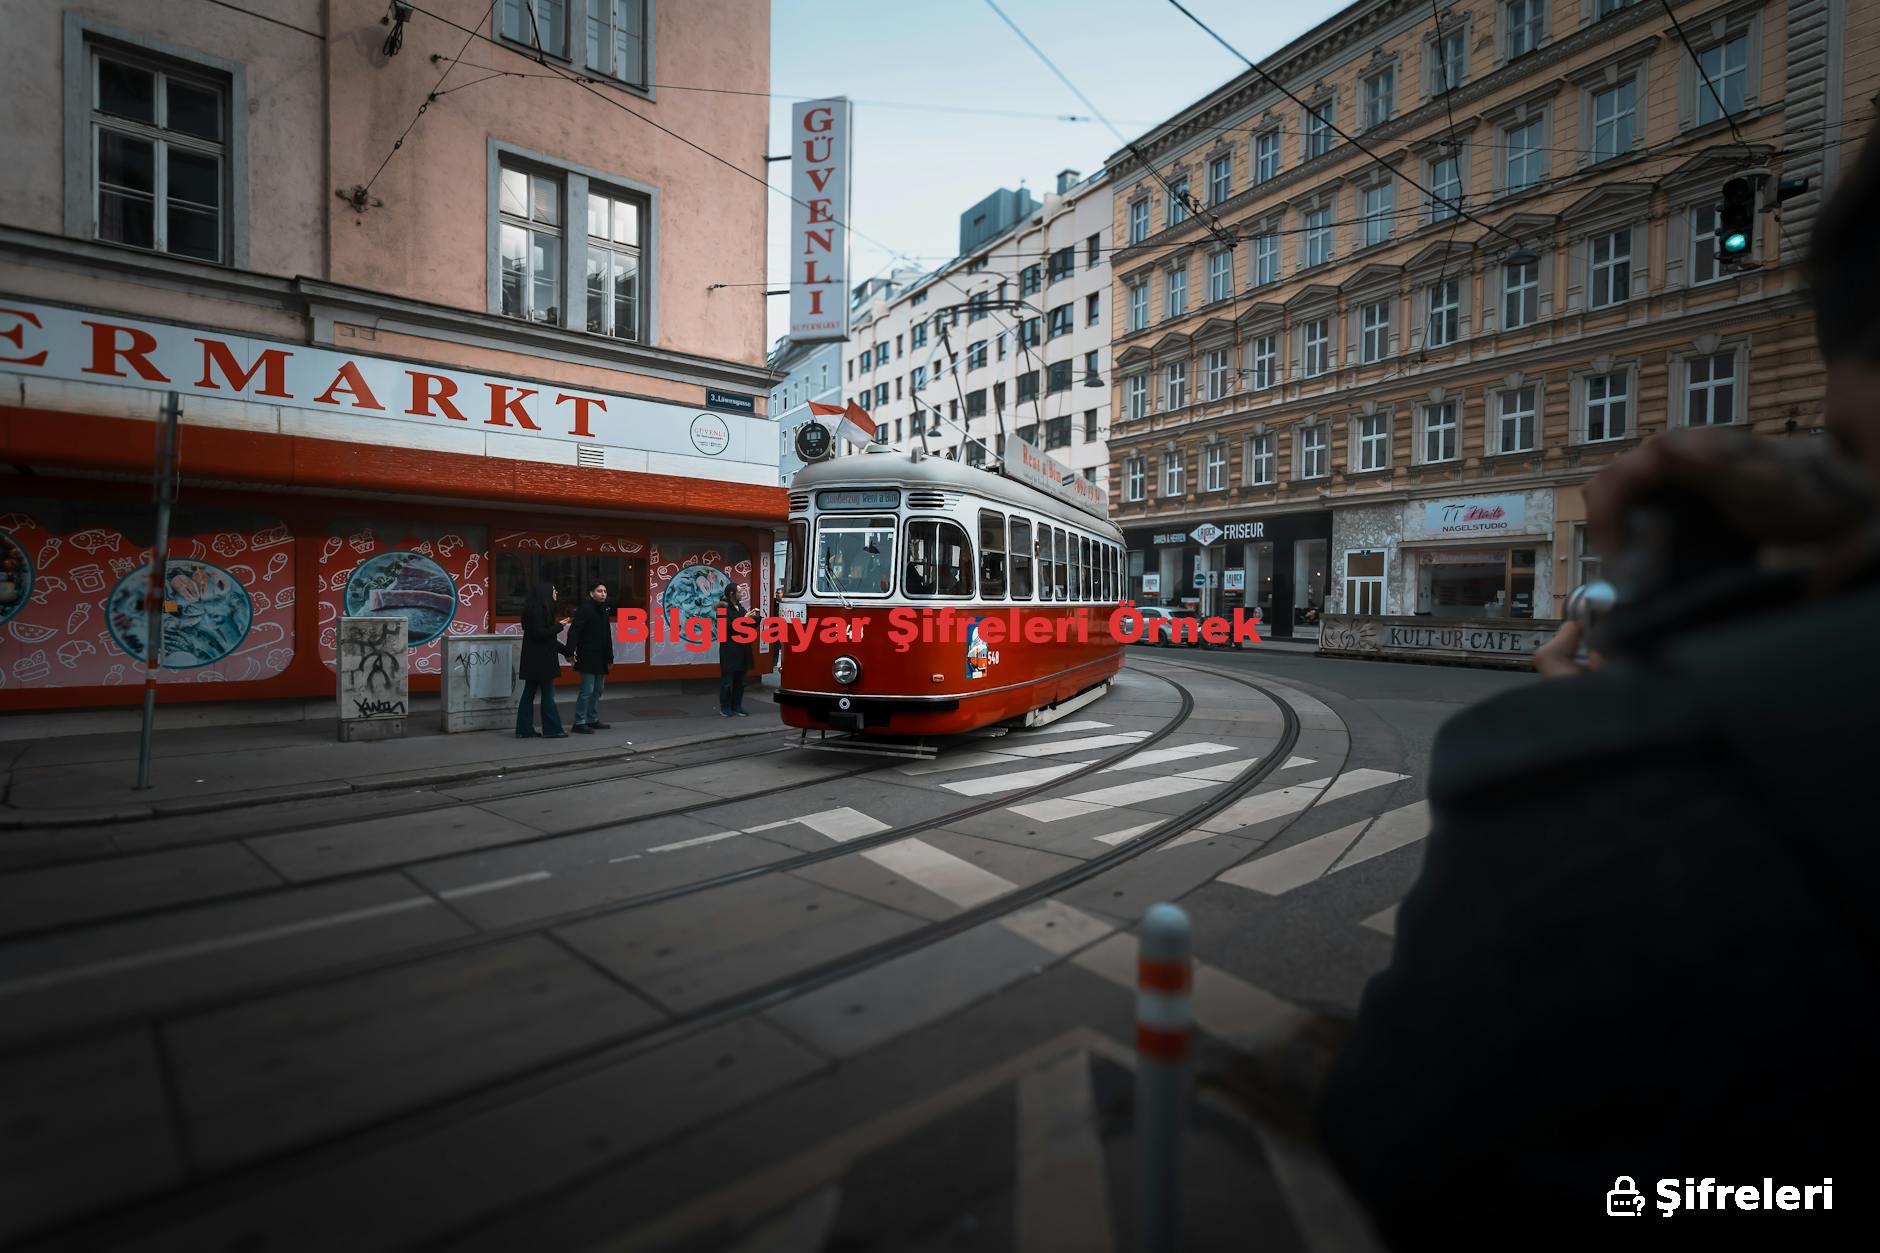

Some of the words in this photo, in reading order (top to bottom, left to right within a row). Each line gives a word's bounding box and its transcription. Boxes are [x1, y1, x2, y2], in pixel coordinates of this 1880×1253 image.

[803, 107, 836, 315] GÜVENLI
[1441, 504, 1466, 522] TT
[1468, 505, 1503, 520] Nails
[1223, 522, 1264, 540] FRISEUR
[1442, 522, 1508, 532] NAGELSTUDIO
[1390, 627, 1522, 650] KULT-UR-CAFE
[988, 650, 1000, 665] 548
